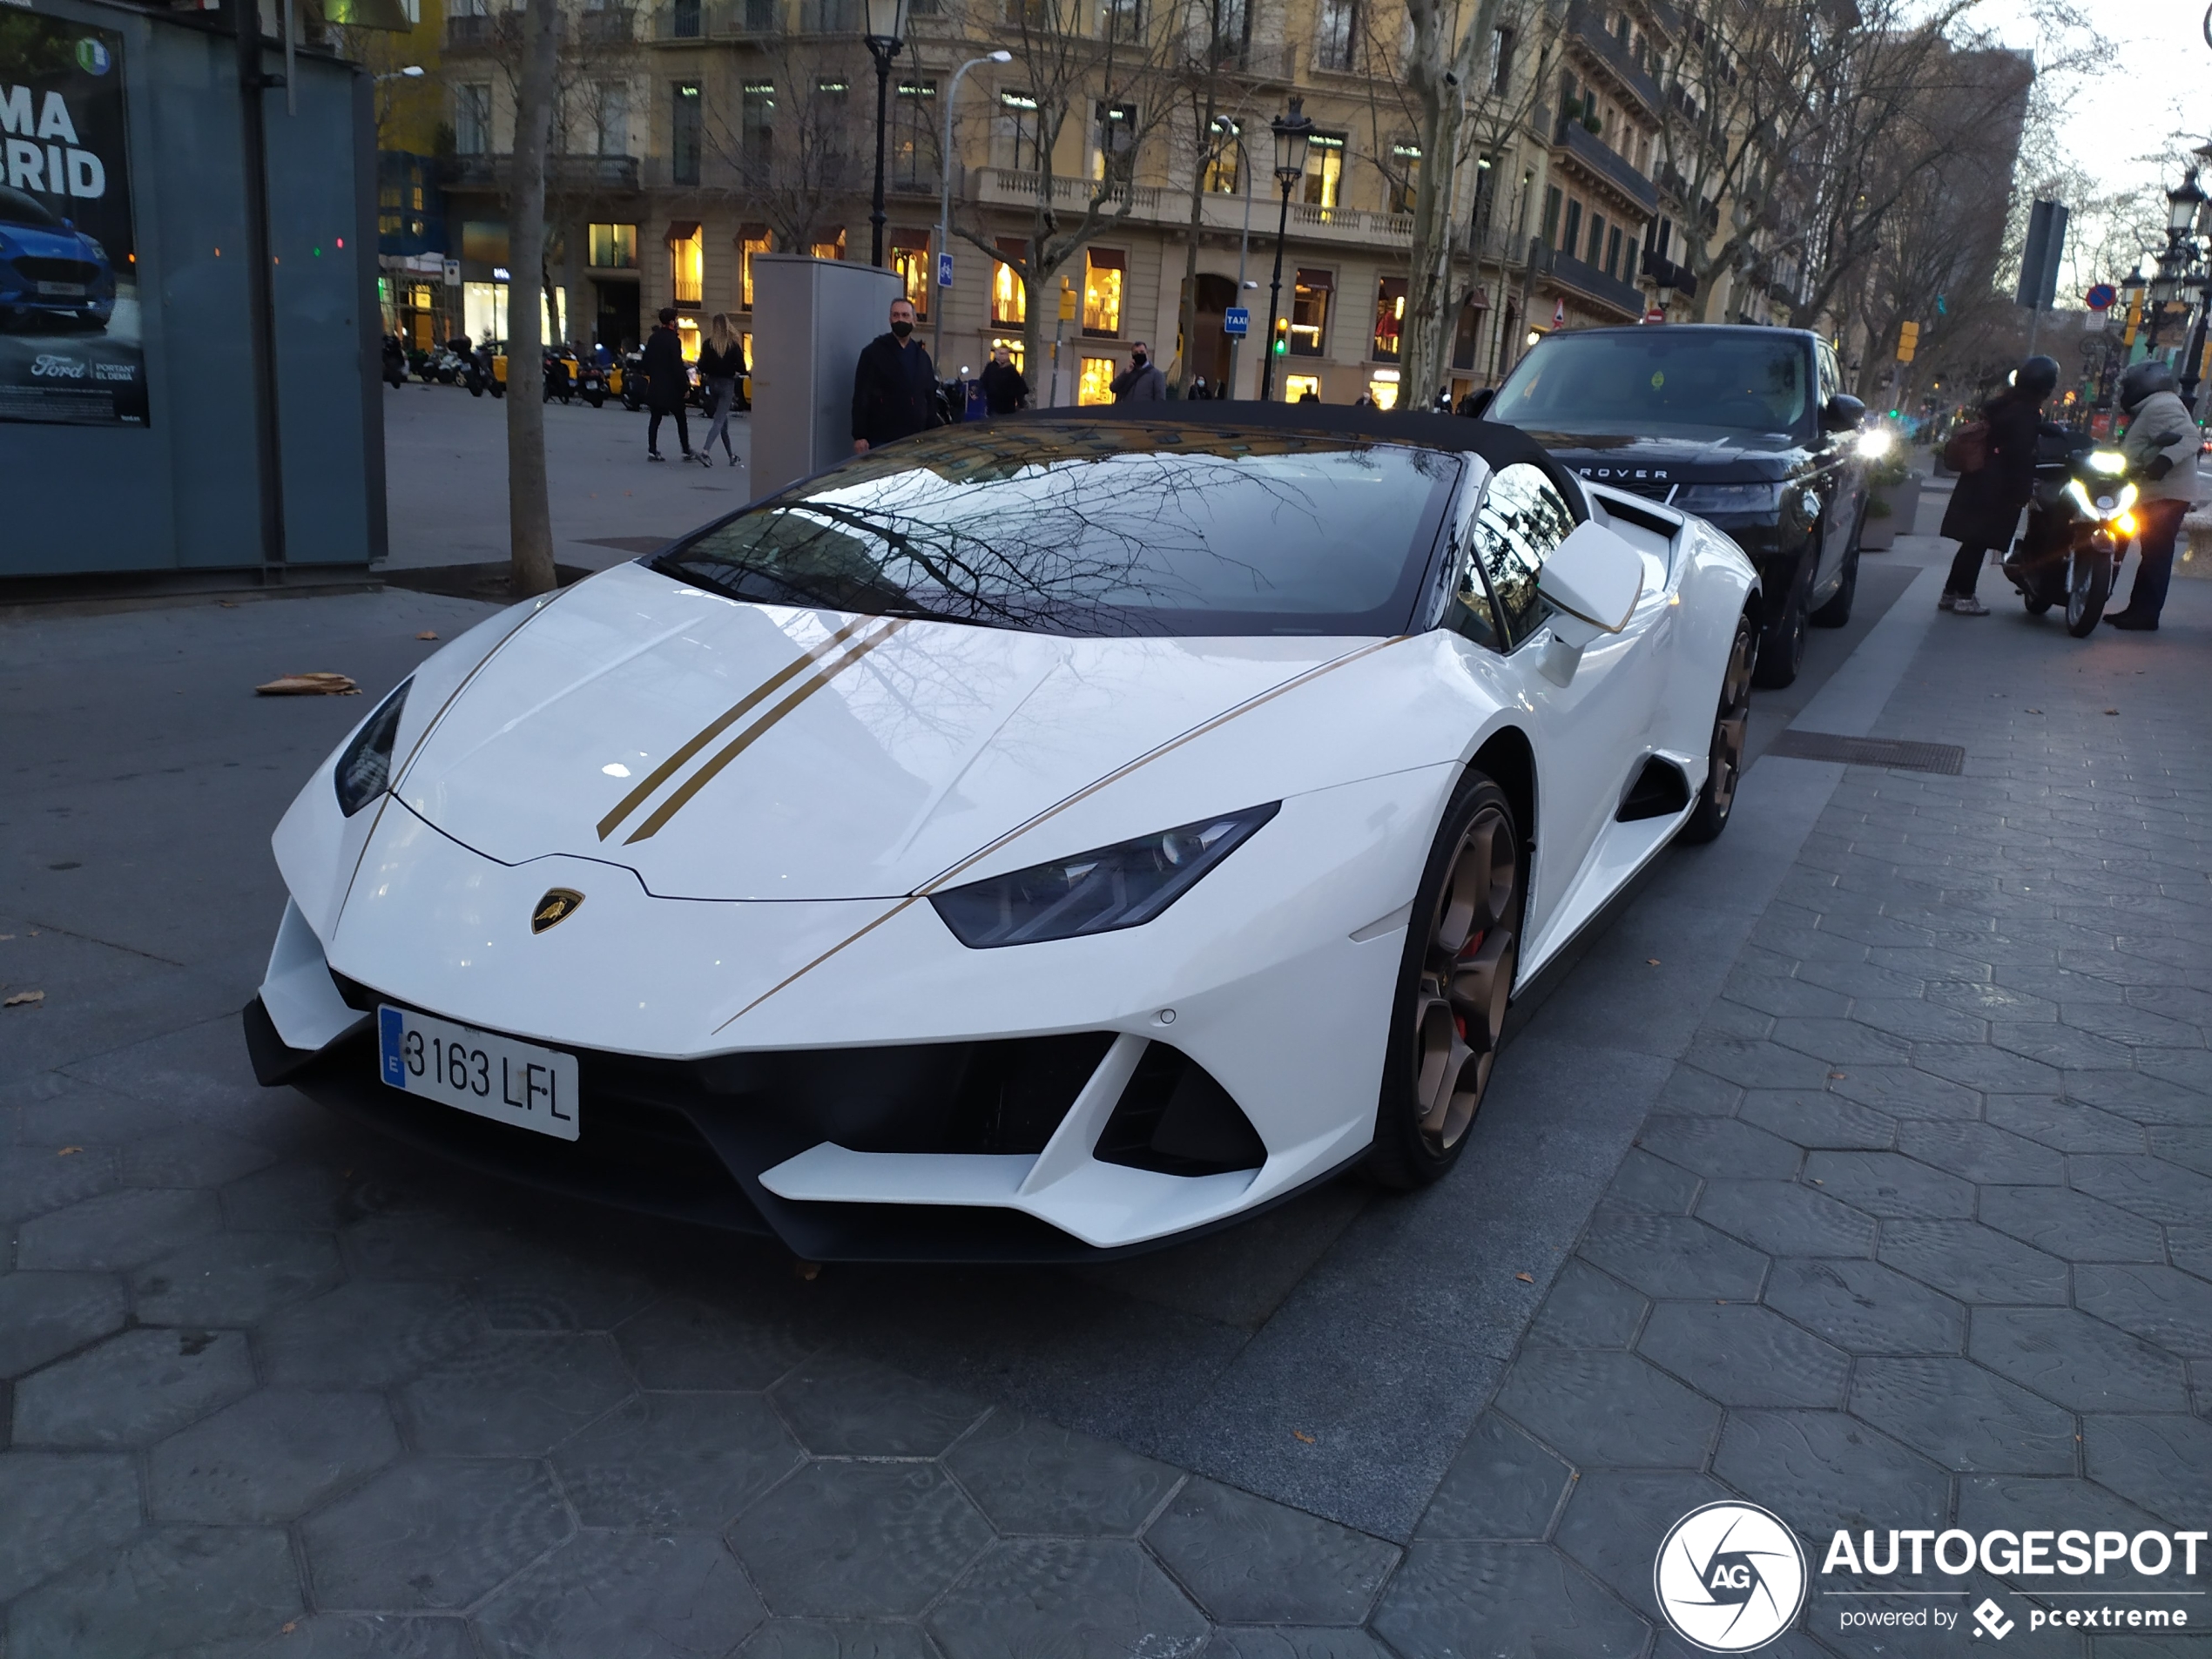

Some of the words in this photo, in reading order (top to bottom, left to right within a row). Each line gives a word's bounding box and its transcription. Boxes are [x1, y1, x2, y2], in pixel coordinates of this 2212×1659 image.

[0, 138, 105, 199] RID
[1228, 315, 1247, 325] TAXI
[30, 354, 85, 379] Ford
[95, 362, 136, 373] PORTANT
[1579, 468, 1668, 478] ROVER
[388, 1055, 400, 1074] E
[502, 1055, 571, 1122] LFL
